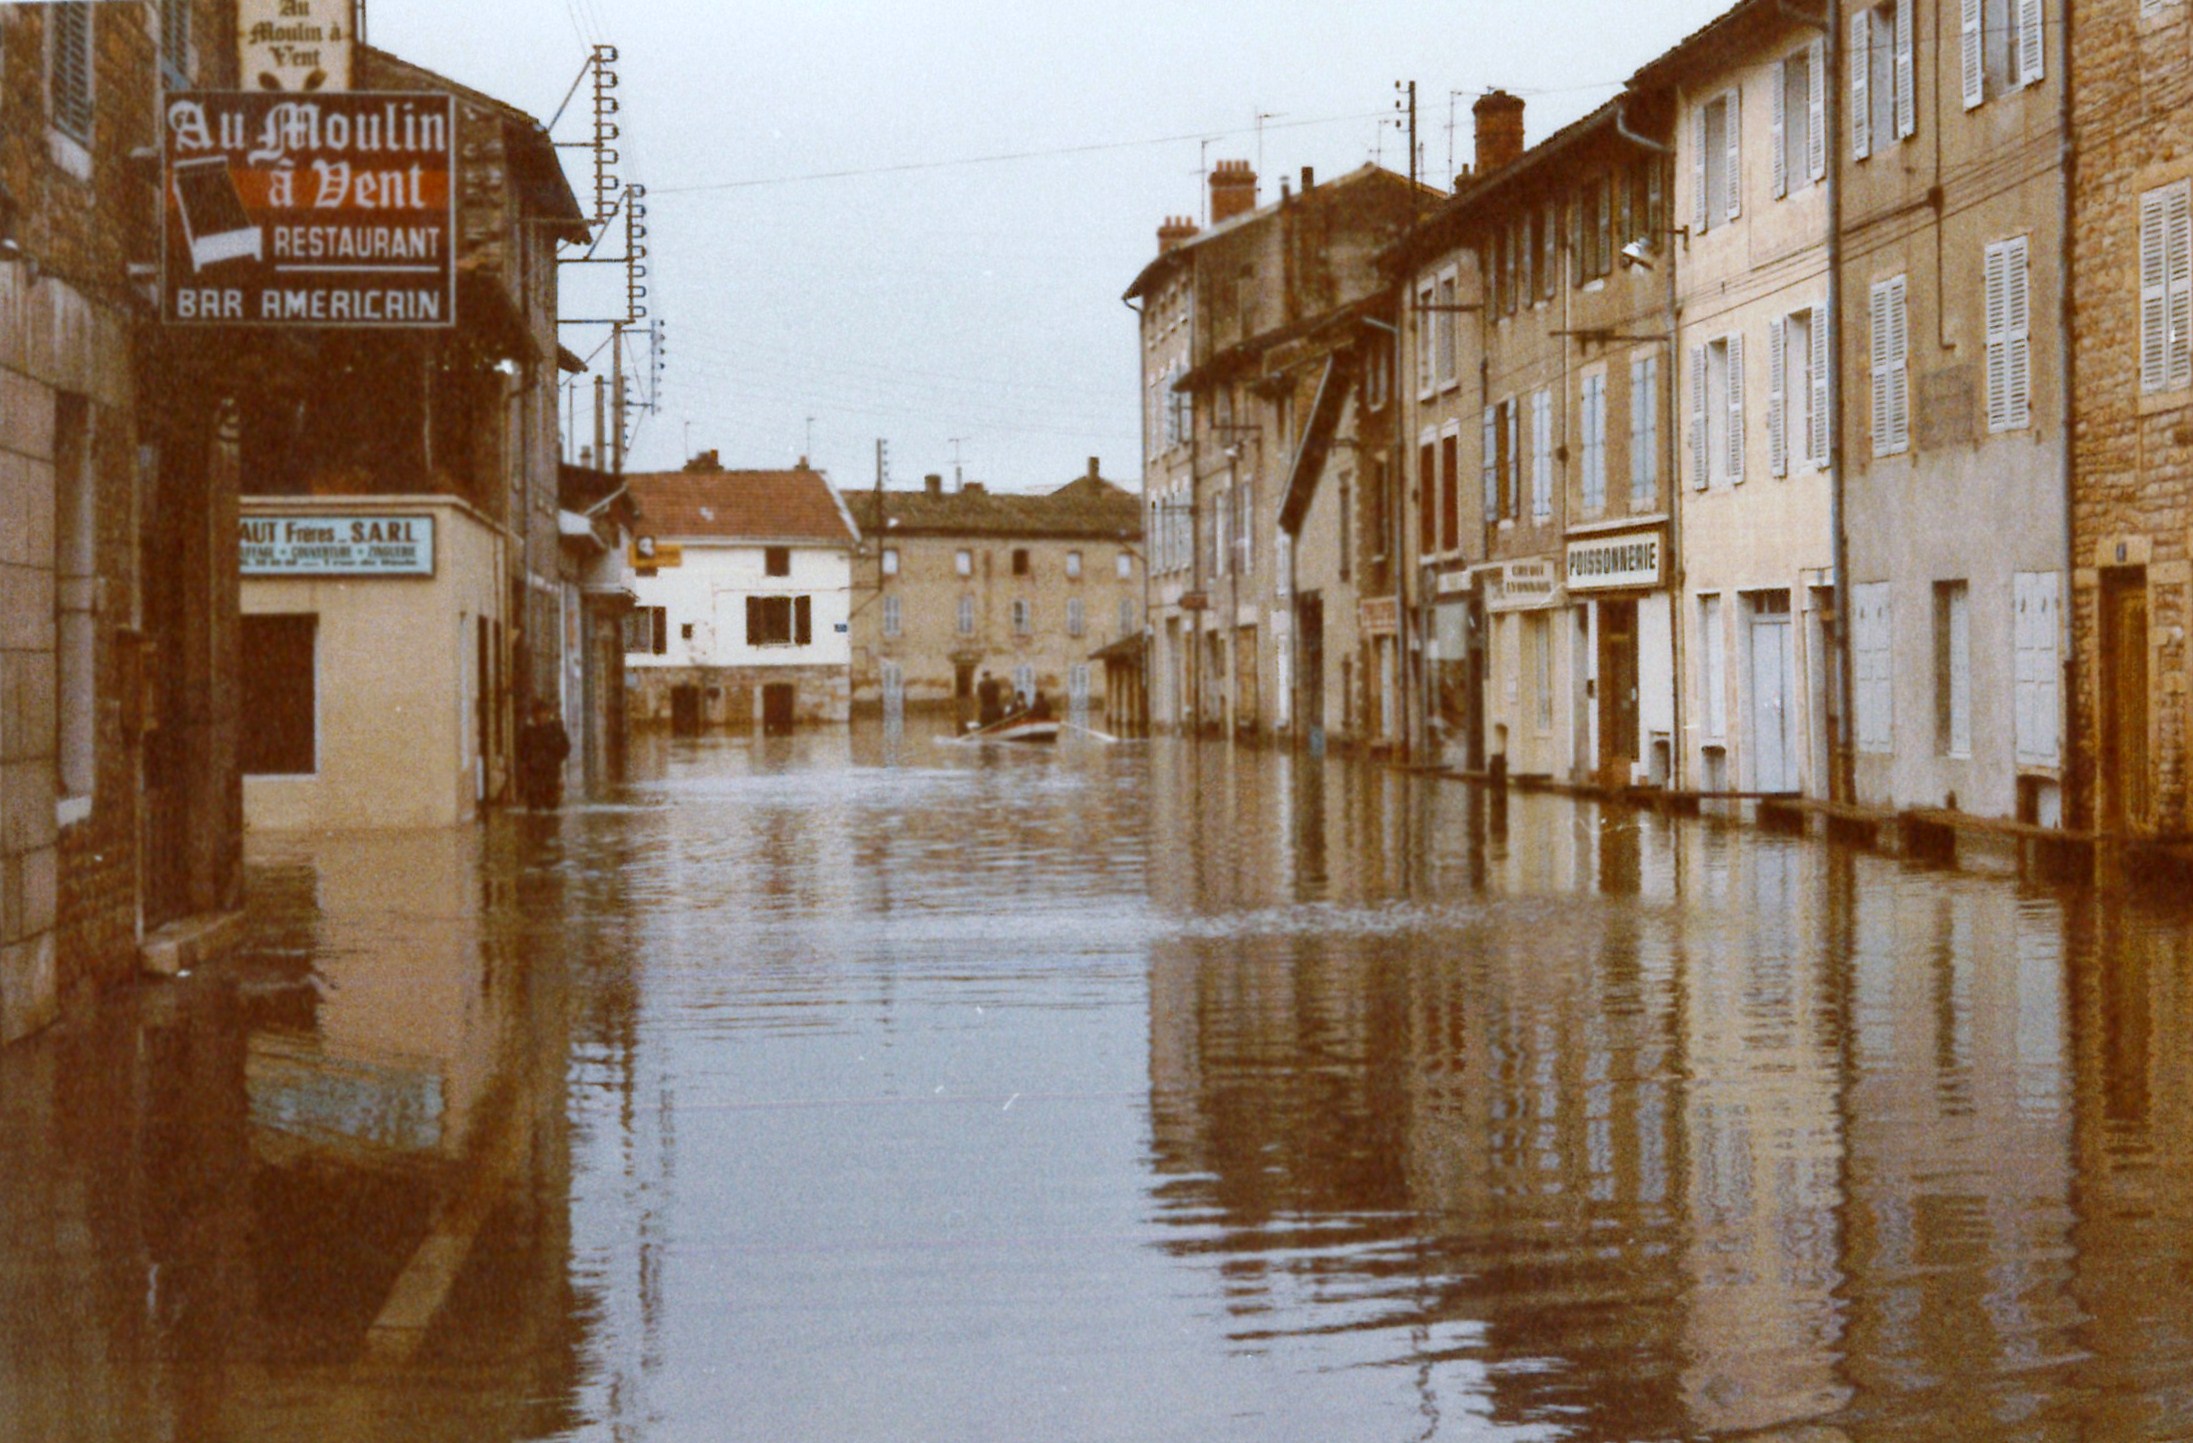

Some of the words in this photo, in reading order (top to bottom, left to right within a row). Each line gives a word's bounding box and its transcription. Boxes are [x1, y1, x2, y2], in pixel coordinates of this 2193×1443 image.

[248, 21, 322, 45] Moulin
[268, 45, 320, 67] Vent
[168, 100, 245, 151] Au
[247, 101, 446, 166] Moulin
[311, 158, 426, 209] Vent
[274, 226, 440, 258] RESTAURANT
[177, 289, 243, 318] BAR
[261, 289, 440, 320] AMERICAIN
[285, 522, 335, 544] Frères
[1569, 542, 1656, 576] POISSONNERIE
